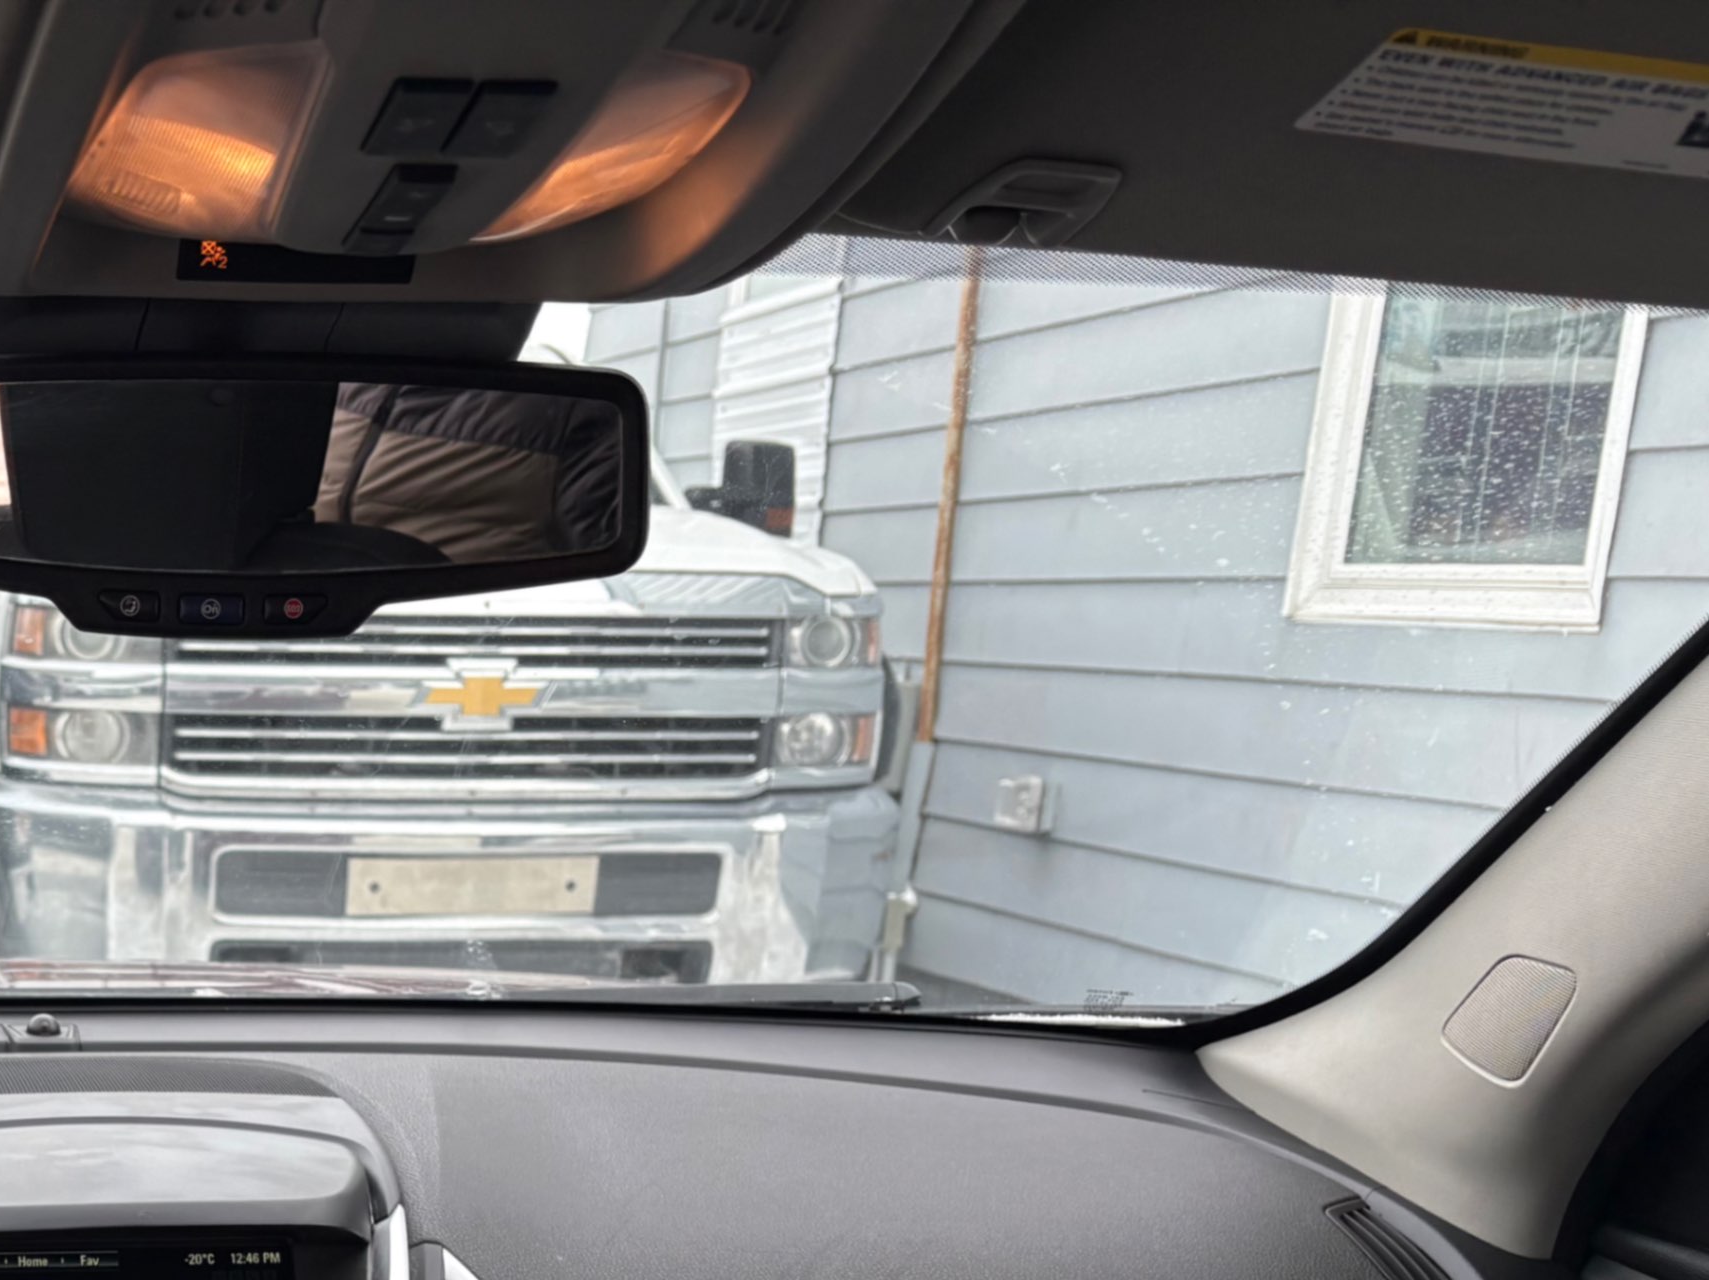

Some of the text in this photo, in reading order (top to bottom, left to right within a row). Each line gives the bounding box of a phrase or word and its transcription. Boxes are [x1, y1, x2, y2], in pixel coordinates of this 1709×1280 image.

[1379, 49, 1434, 64] EVEN
[18, 1255, 48, 1267] Home
[80, 1254, 100, 1266] Fav
[184, 1253, 215, 1266] -20°C
[230, 1251, 281, 1265] 12:46 PM
